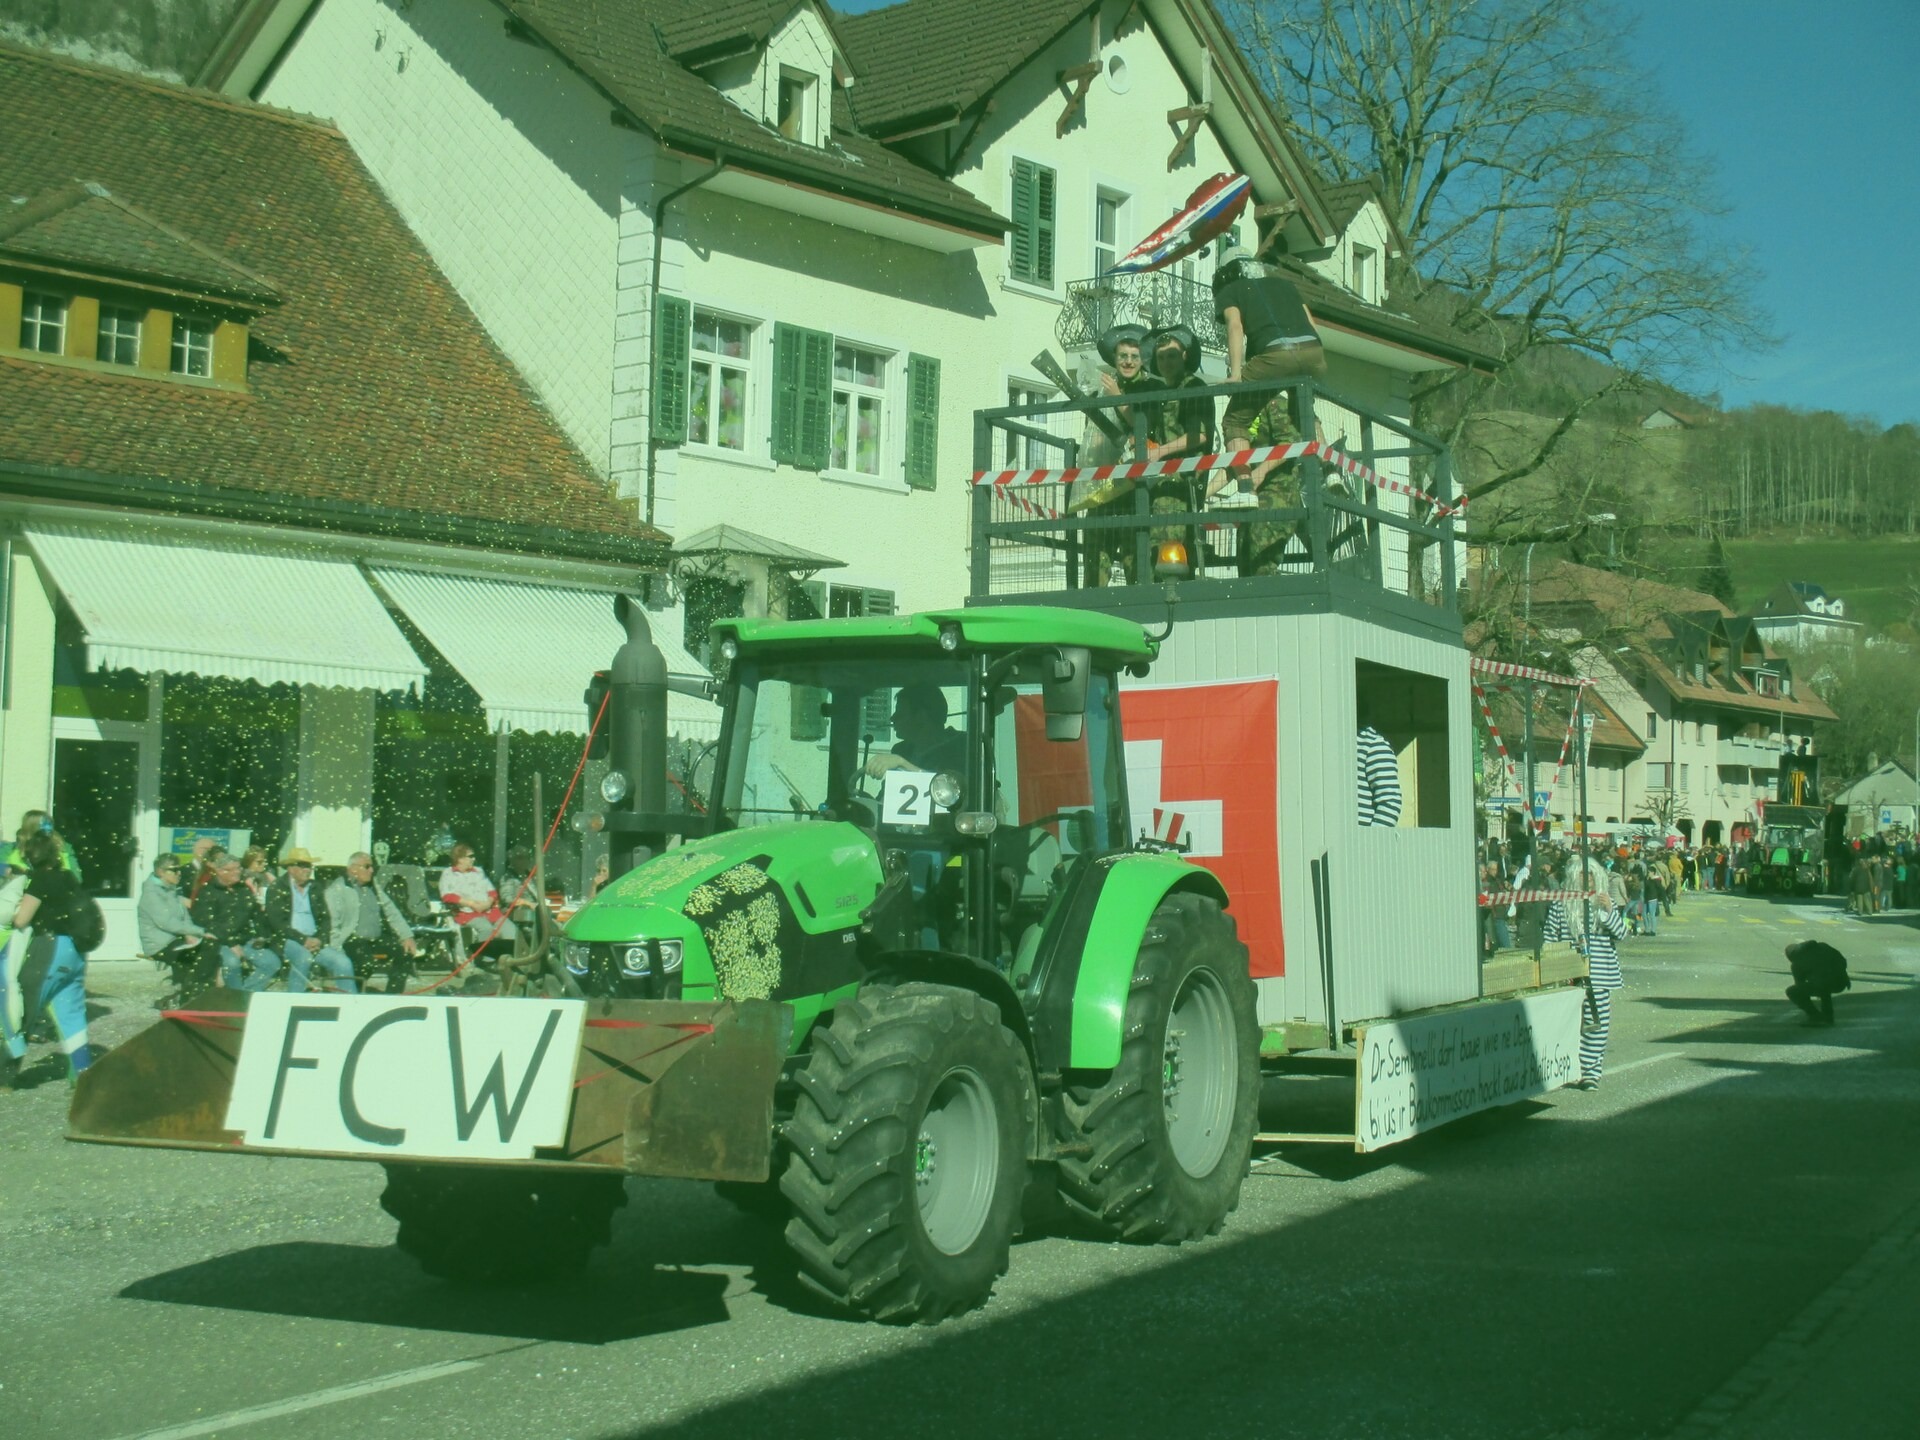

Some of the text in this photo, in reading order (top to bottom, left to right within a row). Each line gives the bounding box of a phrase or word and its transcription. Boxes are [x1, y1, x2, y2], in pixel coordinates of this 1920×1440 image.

[263, 1005, 563, 1146] FCW
[1369, 1097, 1382, 1140] bi
[1383, 1094, 1397, 1136] üs
[1398, 1089, 1406, 1132] ir
[1408, 1074, 1476, 1127] Baukommission
[1478, 1062, 1501, 1104] hockt
[1553, 1043, 1571, 1083] Sepp
[1370, 1042, 1386, 1084] Dr
[1388, 1030, 1436, 1079] Sembinelli
[1484, 1019, 1499, 1056] wie
[1513, 1013, 1532, 1059] Depp
